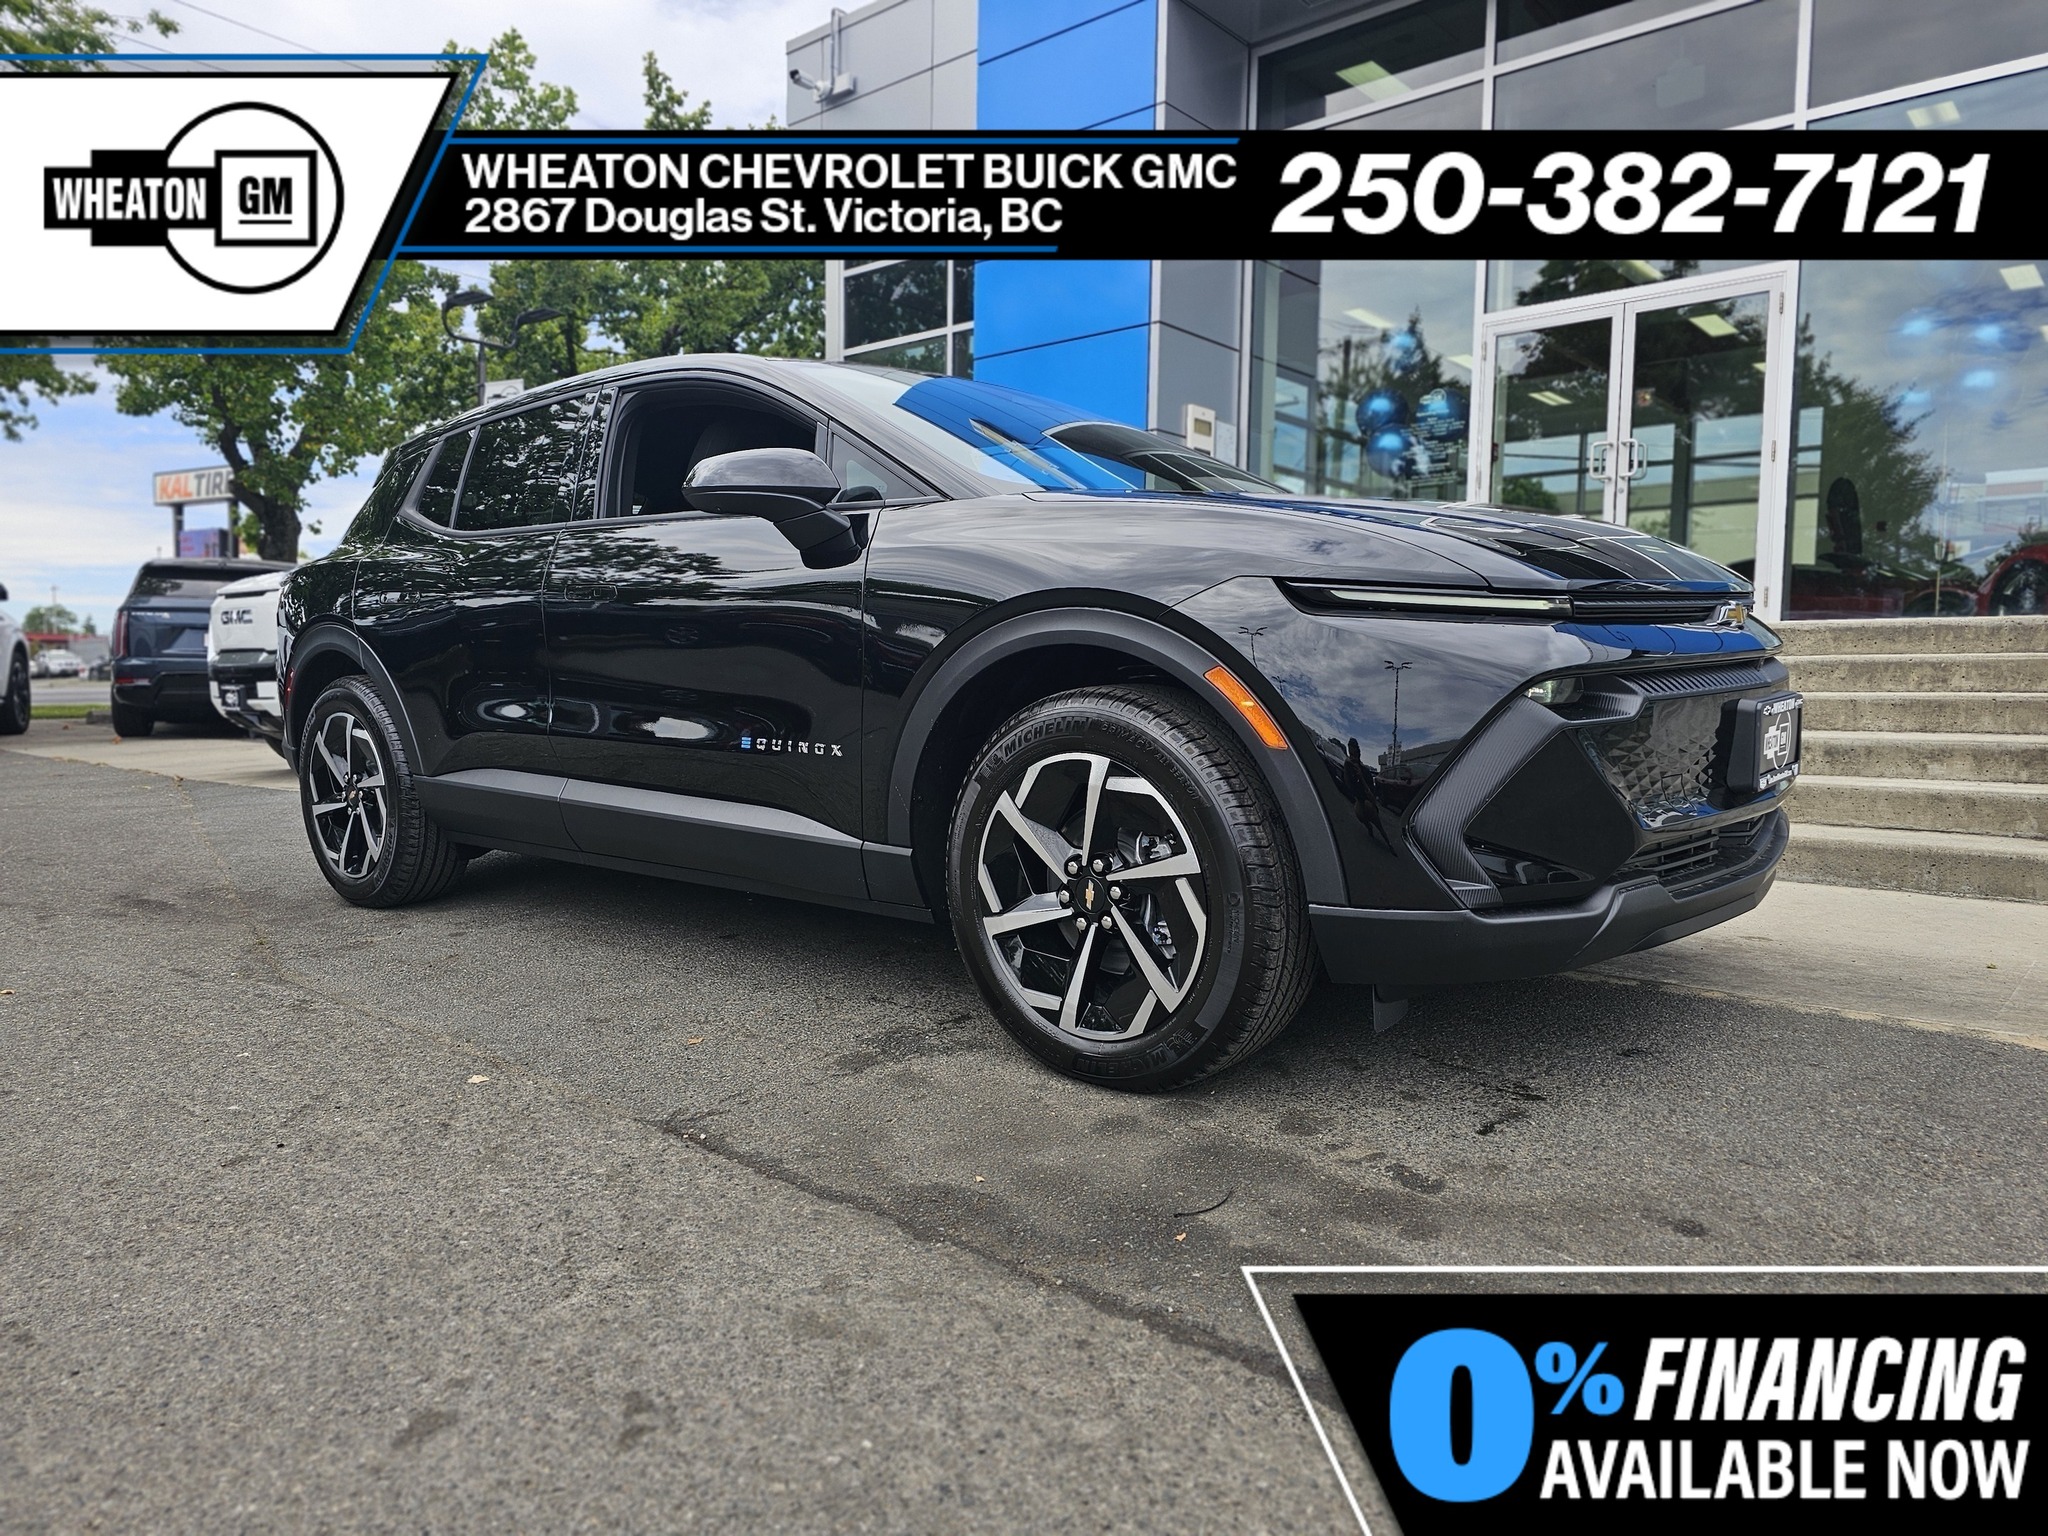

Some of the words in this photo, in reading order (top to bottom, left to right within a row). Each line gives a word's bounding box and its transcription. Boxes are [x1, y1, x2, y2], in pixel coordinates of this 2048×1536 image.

[159, 474, 192, 498] KAL
[221, 610, 253, 625] GMC
[741, 737, 843, 757] EQUINOX
[1003, 718, 1090, 758] MICHELIN
